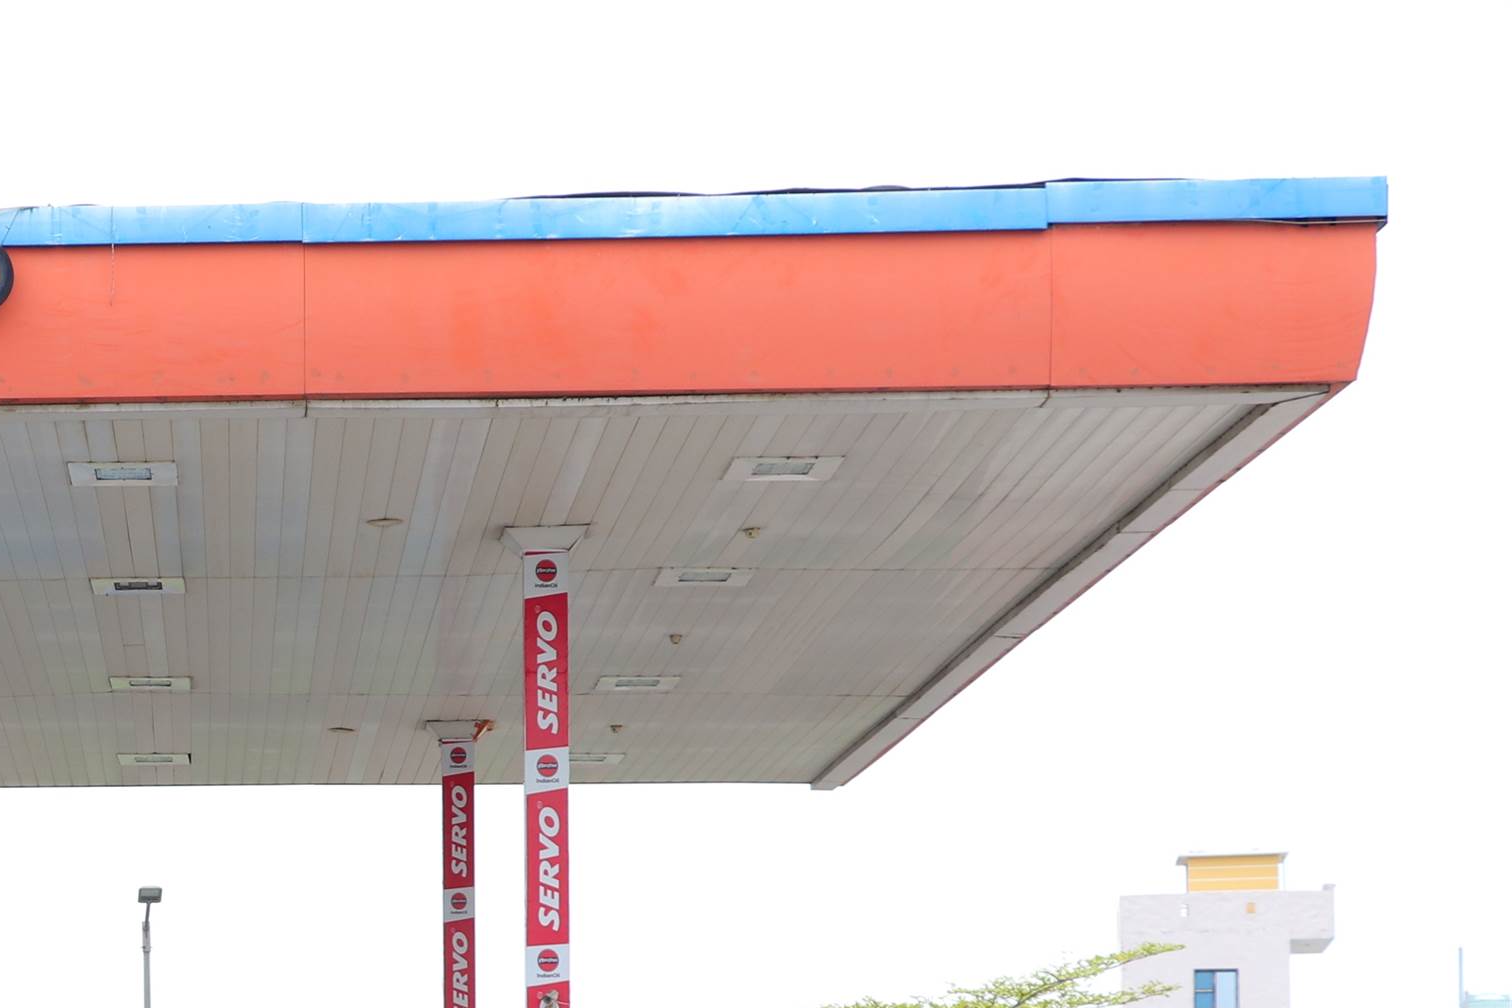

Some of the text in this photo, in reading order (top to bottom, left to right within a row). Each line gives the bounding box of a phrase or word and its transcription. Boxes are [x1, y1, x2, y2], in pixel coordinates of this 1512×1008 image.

[536, 610, 559, 735] SERVO
[451, 784, 468, 878] SERVO
[538, 806, 560, 931] SERVO
